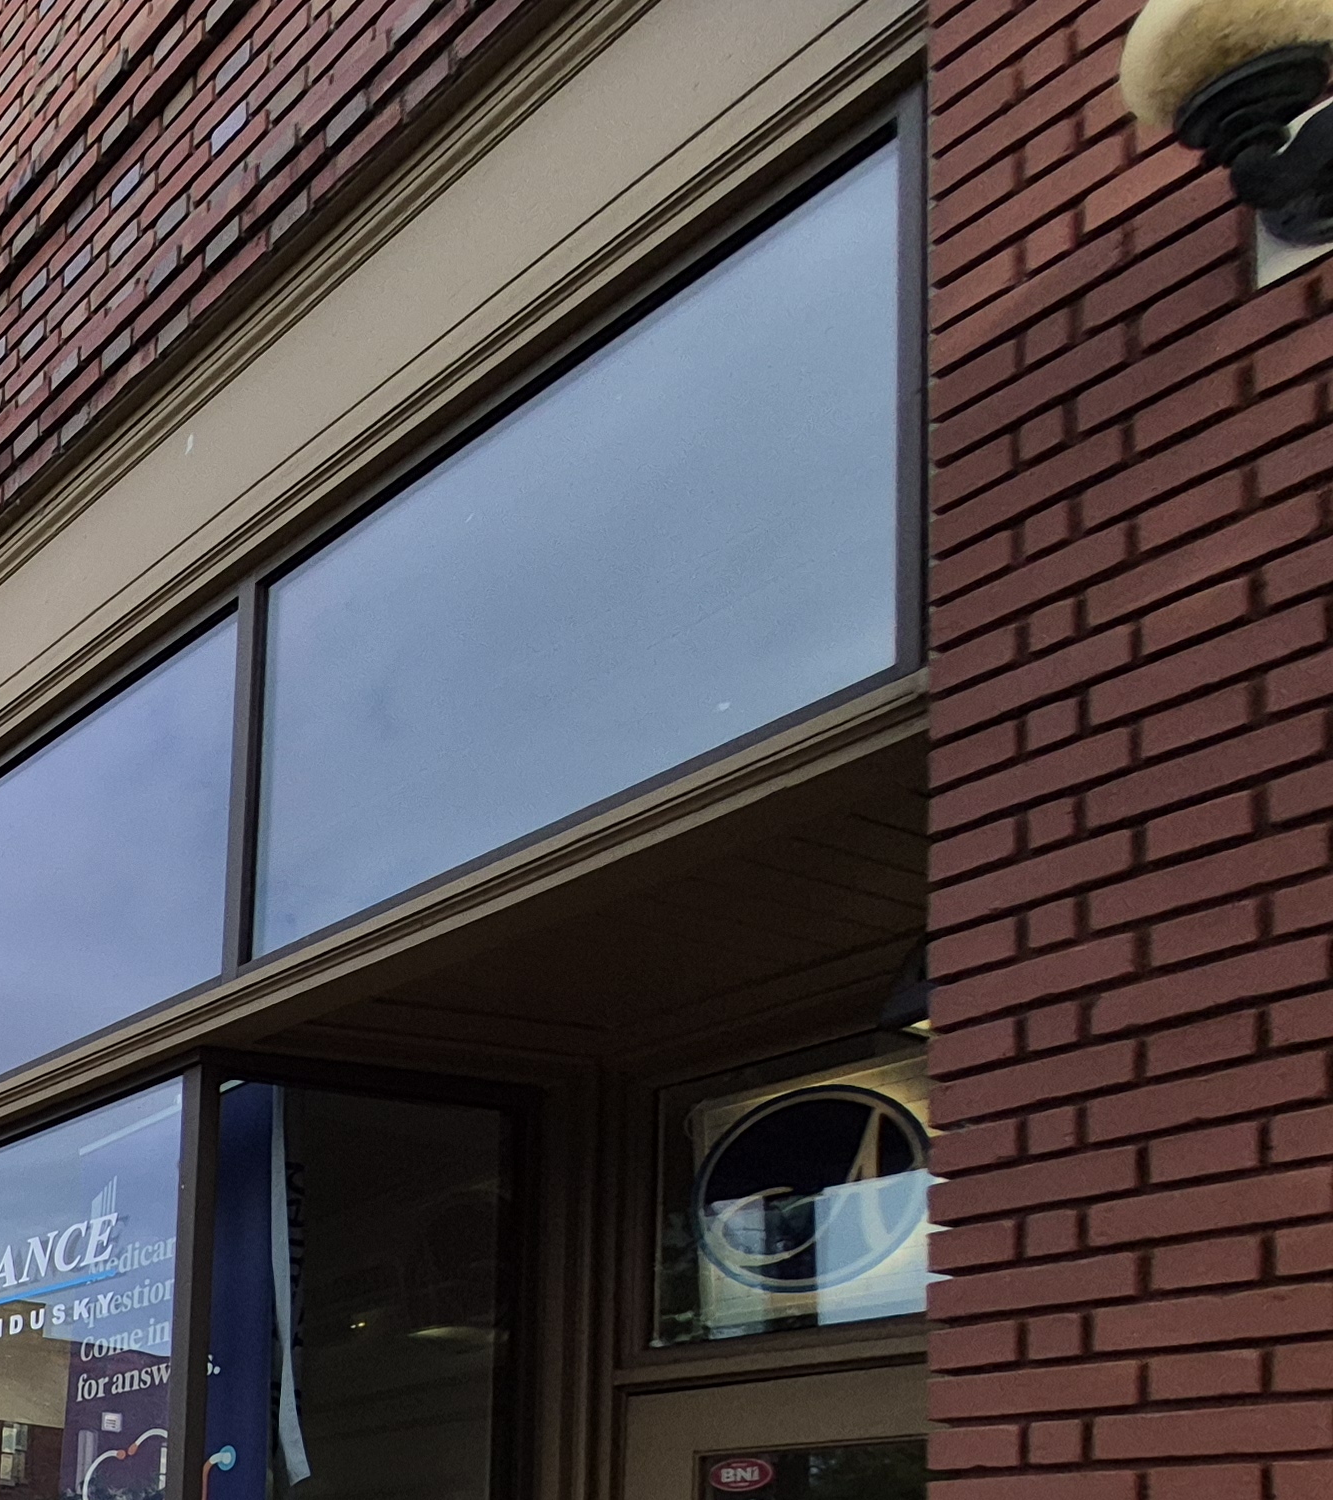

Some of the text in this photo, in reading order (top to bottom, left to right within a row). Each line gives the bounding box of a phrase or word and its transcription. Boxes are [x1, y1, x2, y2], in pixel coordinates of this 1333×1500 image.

[79, 1326, 144, 1362] Come
[76, 1373, 112, 1402] for
[720, 1467, 760, 1483] BNI
